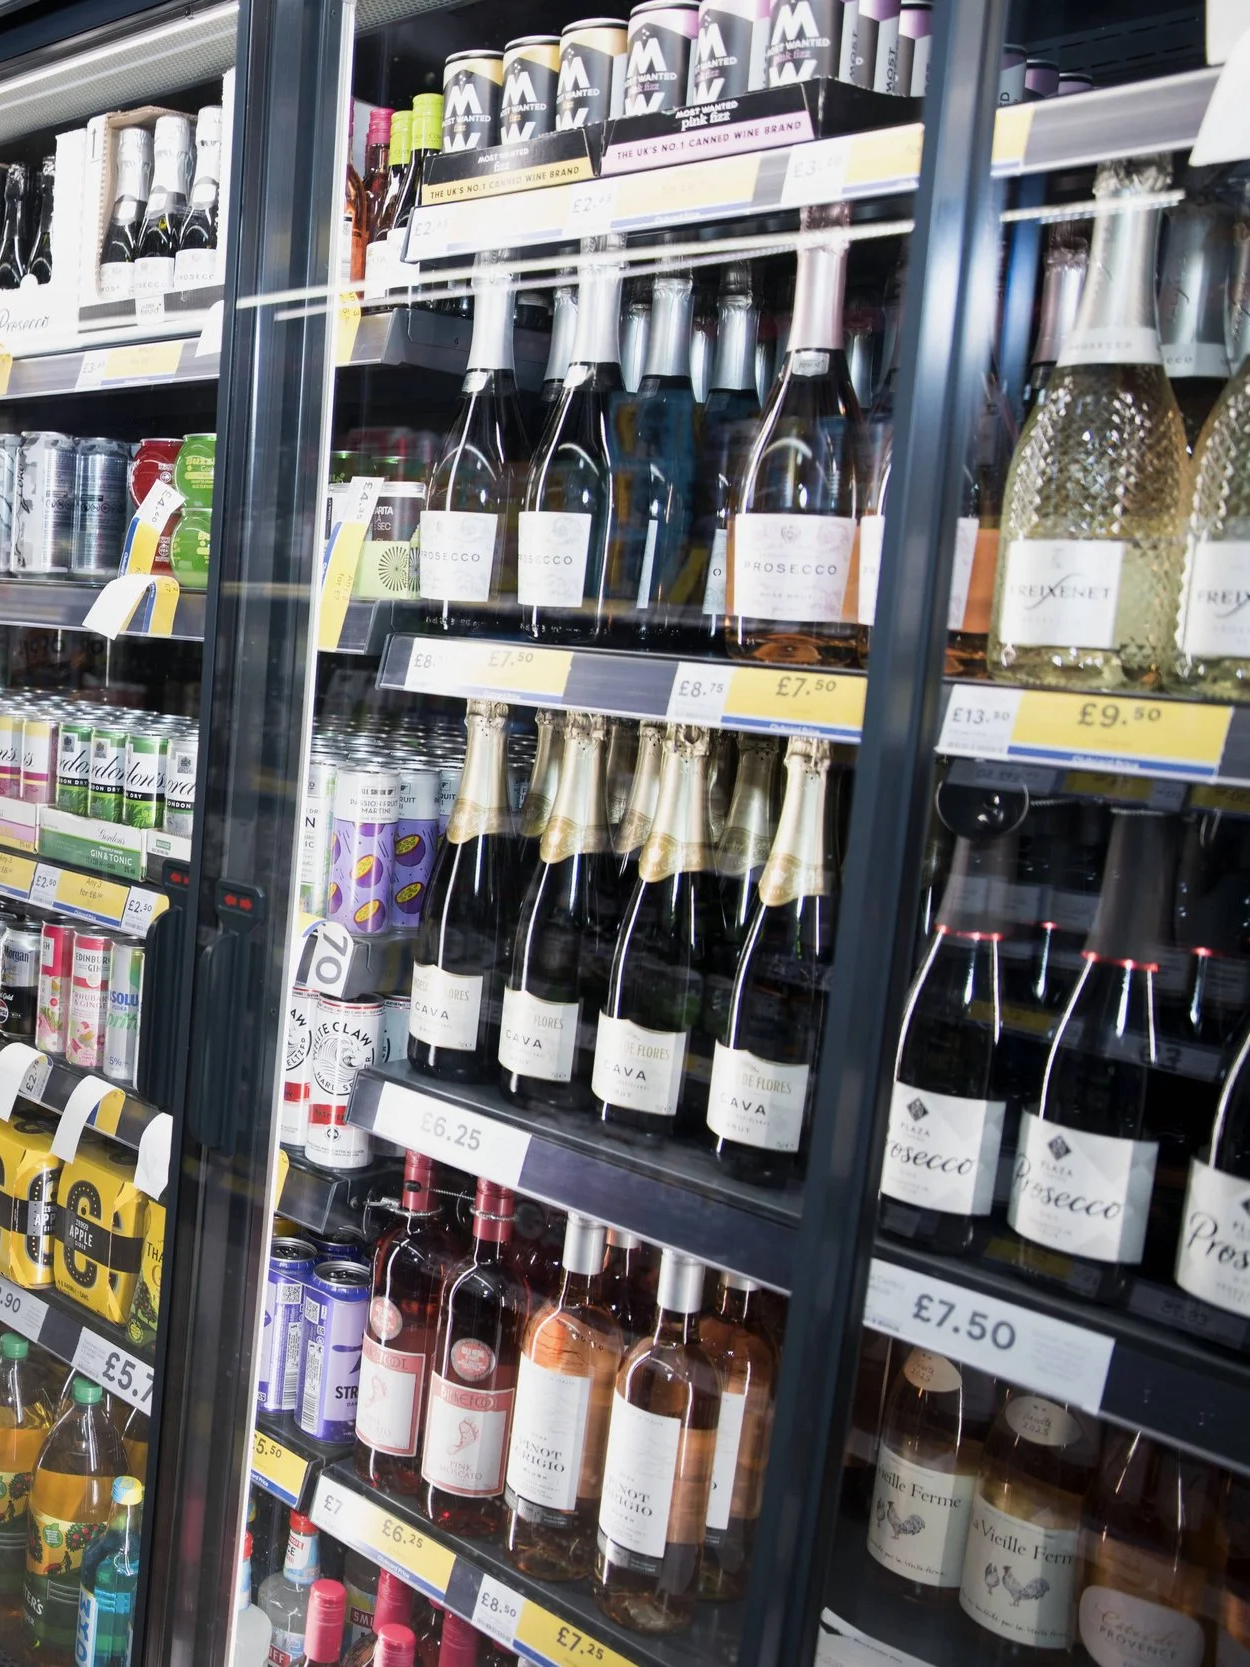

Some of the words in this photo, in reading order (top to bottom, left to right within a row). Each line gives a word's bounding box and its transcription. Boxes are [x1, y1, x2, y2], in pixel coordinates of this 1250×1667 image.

[786, 37, 831, 49] WANTED
[639, 72, 678, 83] WANTED
[565, 89, 600, 99] WANTED
[512, 103, 547, 113] WANTED
[675, 107, 700, 119] MOST
[701, 100, 739, 115] WANTED
[457, 115, 491, 123] WANTED
[681, 114, 708, 131] pink
[709, 111, 731, 124] fizz
[617, 150, 634, 160] THE
[636, 145, 658, 157] UK'S
[661, 140, 685, 152] NO.1
[688, 132, 730, 148] CANNED
[733, 128, 760, 140] WINE
[764, 120, 802, 135] BRAND
[478, 154, 498, 164] MOST
[499, 148, 529, 160] WANTED
[430, 189, 445, 200] THE
[447, 186, 464, 197] UK'S
[467, 183, 486, 193] NO.1
[489, 176, 522, 190] CANNED
[525, 171, 546, 183] WINE
[550, 166, 580, 179] BRAND
[744, 561, 837, 576] PROSECCO
[1009, 583, 1112, 602] FREIXENET
[1197, 585, 1250, 607] FREIX
[488, 650, 534, 668] £7.50
[678, 681, 724, 697] £8.75
[776, 675, 837, 697] £7.50
[1077, 702, 1162, 729] £9.50
[167, 801, 192, 809] ONDON
[35, 876, 57, 888] £2.50
[86, 879, 96, 888] Any
[80, 888, 88, 896] for
[128, 900, 152, 914] £2.50
[4, 945, 30, 963] Morgan
[76, 952, 110, 965] EDINBUR
[75, 991, 107, 1002] RHUBAR
[112, 990, 139, 1007] SOLU
[415, 1001, 449, 1020] CAVA
[534, 1013, 565, 1031] FLORES
[313, 1024, 330, 1061] WHITE
[332, 1020, 373, 1048] CLAW
[505, 1029, 543, 1051] CAVA
[636, 1045, 670, 1062] FLORES
[603, 1059, 647, 1083] CAVA
[742, 1073, 754, 1088] DE
[755, 1075, 793, 1095] FLORES
[720, 1092, 767, 1117] CAVA
[420, 1111, 482, 1152] £6.25
[901, 1121, 930, 1138] PLAZA
[887, 1138, 977, 1176] rosecco
[1040, 1160, 1073, 1179] PLAZA
[1013, 1153, 1121, 1221] Prosecco
[34, 1213, 57, 1228] APP
[69, 1226, 93, 1248] APPLE
[74, 1240, 87, 1251] CIDER
[1189, 1211, 1250, 1272] Pros
[911, 1292, 1017, 1352] £7.50
[102, 1351, 154, 1400] £5.7
[520, 1437, 562, 1460] PINOT
[878, 1464, 906, 1493] ieille
[911, 1483, 962, 1508] Ferme
[324, 1495, 344, 1514] £7
[382, 1519, 424, 1549] £6.25
[981, 1519, 1027, 1556] Vieille
[1033, 1545, 1074, 1566] Ferm
[23, 1583, 44, 1617] TER'S
[481, 1592, 517, 1617] £8.50
[557, 1626, 605, 1660] £7.25
[1099, 1626, 1178, 1661] PROVENCE
